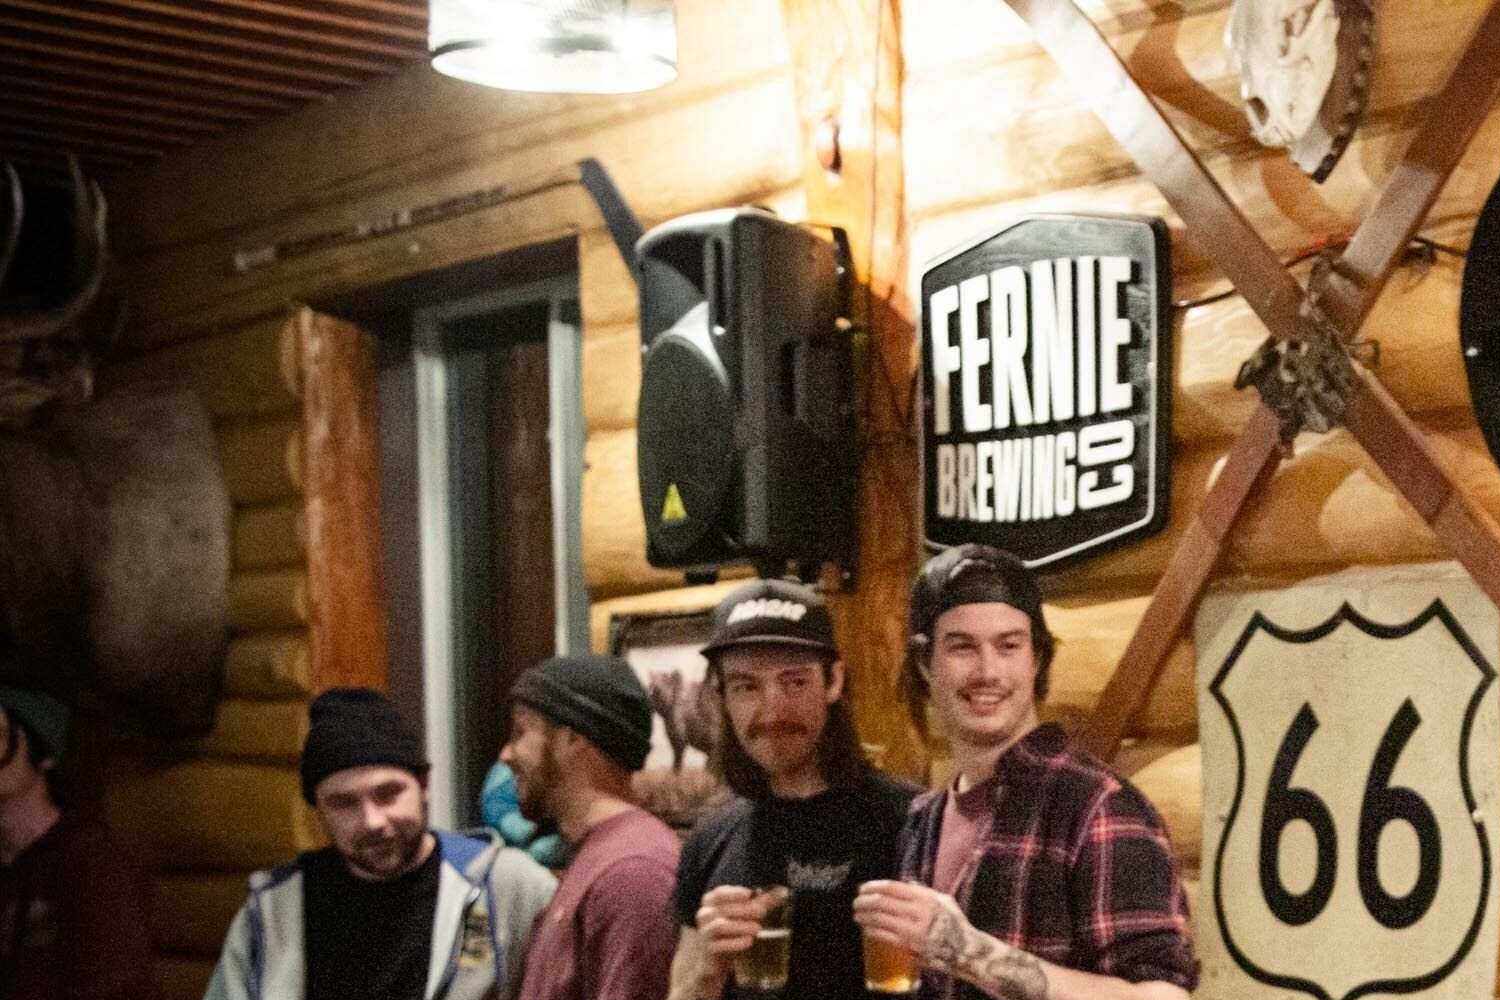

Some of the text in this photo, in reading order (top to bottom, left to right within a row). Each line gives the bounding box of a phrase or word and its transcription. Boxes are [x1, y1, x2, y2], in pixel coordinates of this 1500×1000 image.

[929, 255, 1133, 435] FERNIE
[936, 418, 1135, 522] BREWING CO
[1257, 696, 1443, 930] 66
